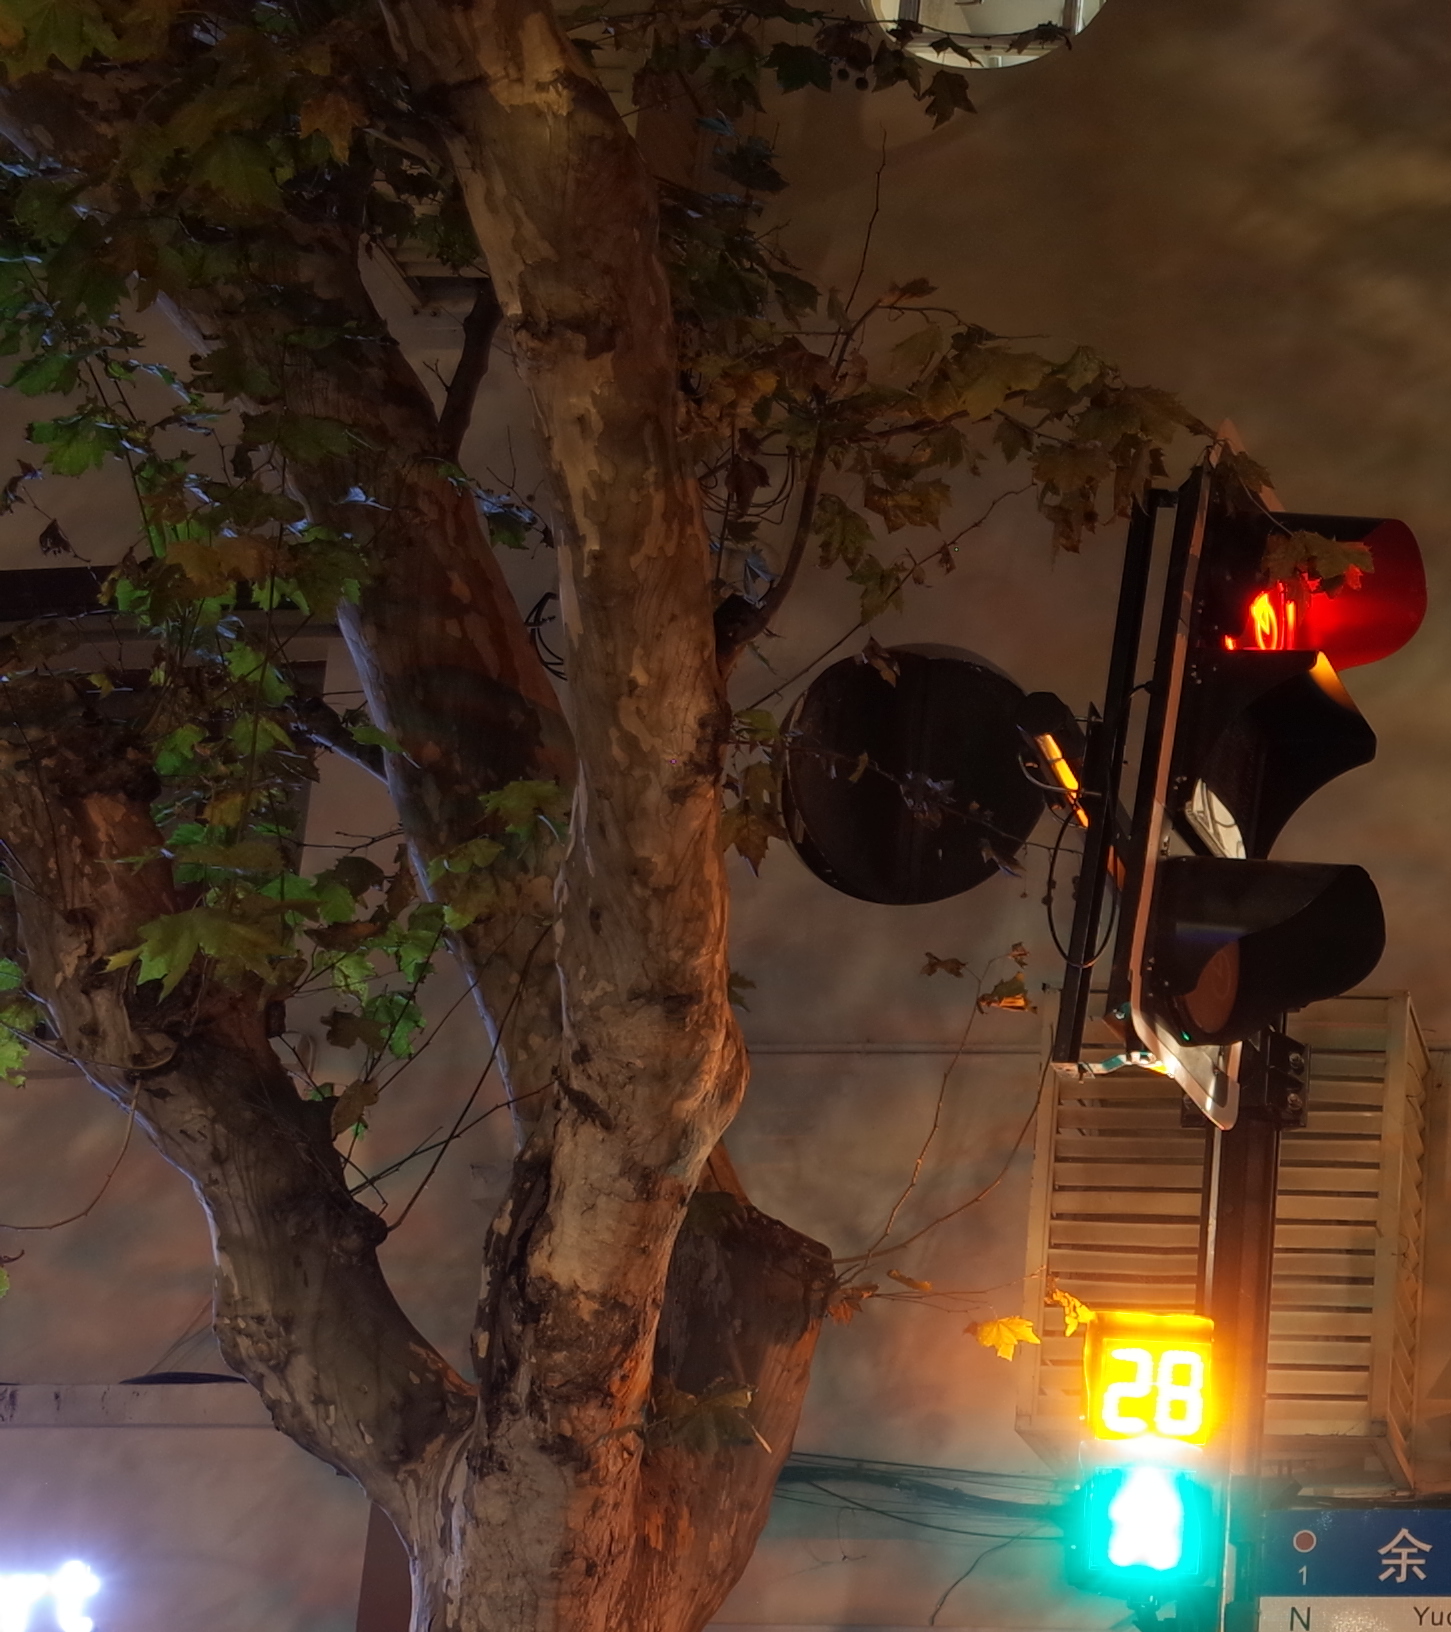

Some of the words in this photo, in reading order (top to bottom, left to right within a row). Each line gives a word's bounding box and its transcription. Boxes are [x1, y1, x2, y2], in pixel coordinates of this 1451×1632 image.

[1103, 1347, 1204, 1436] 28
[1297, 1565, 1308, 1586] 1
[1289, 1606, 1311, 1632] N
